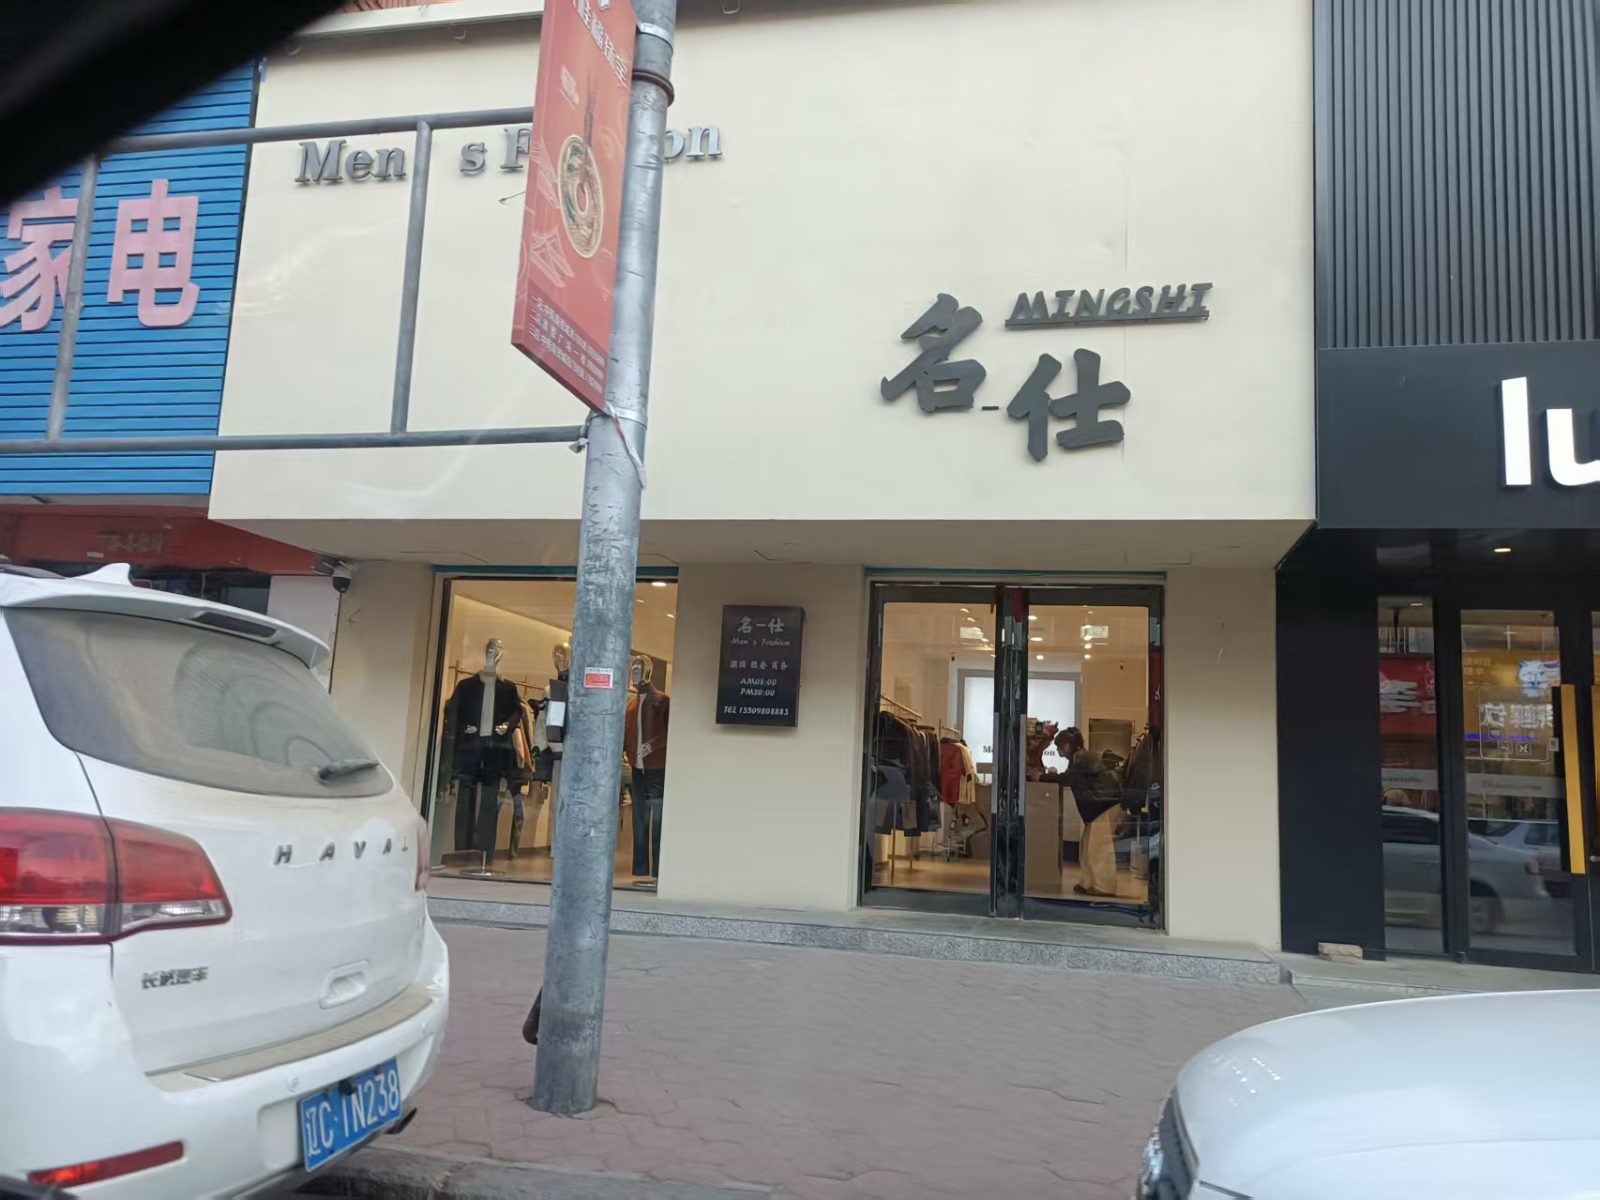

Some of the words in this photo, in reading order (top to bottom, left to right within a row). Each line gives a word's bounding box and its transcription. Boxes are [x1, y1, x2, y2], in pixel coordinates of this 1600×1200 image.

[293, 139, 407, 184] Men
[0, 179, 200, 332] 家电
[1006, 282, 1213, 325] MINGSHI
[723, 705, 737, 714] TEL
[273, 837, 409, 866] HAVAL
